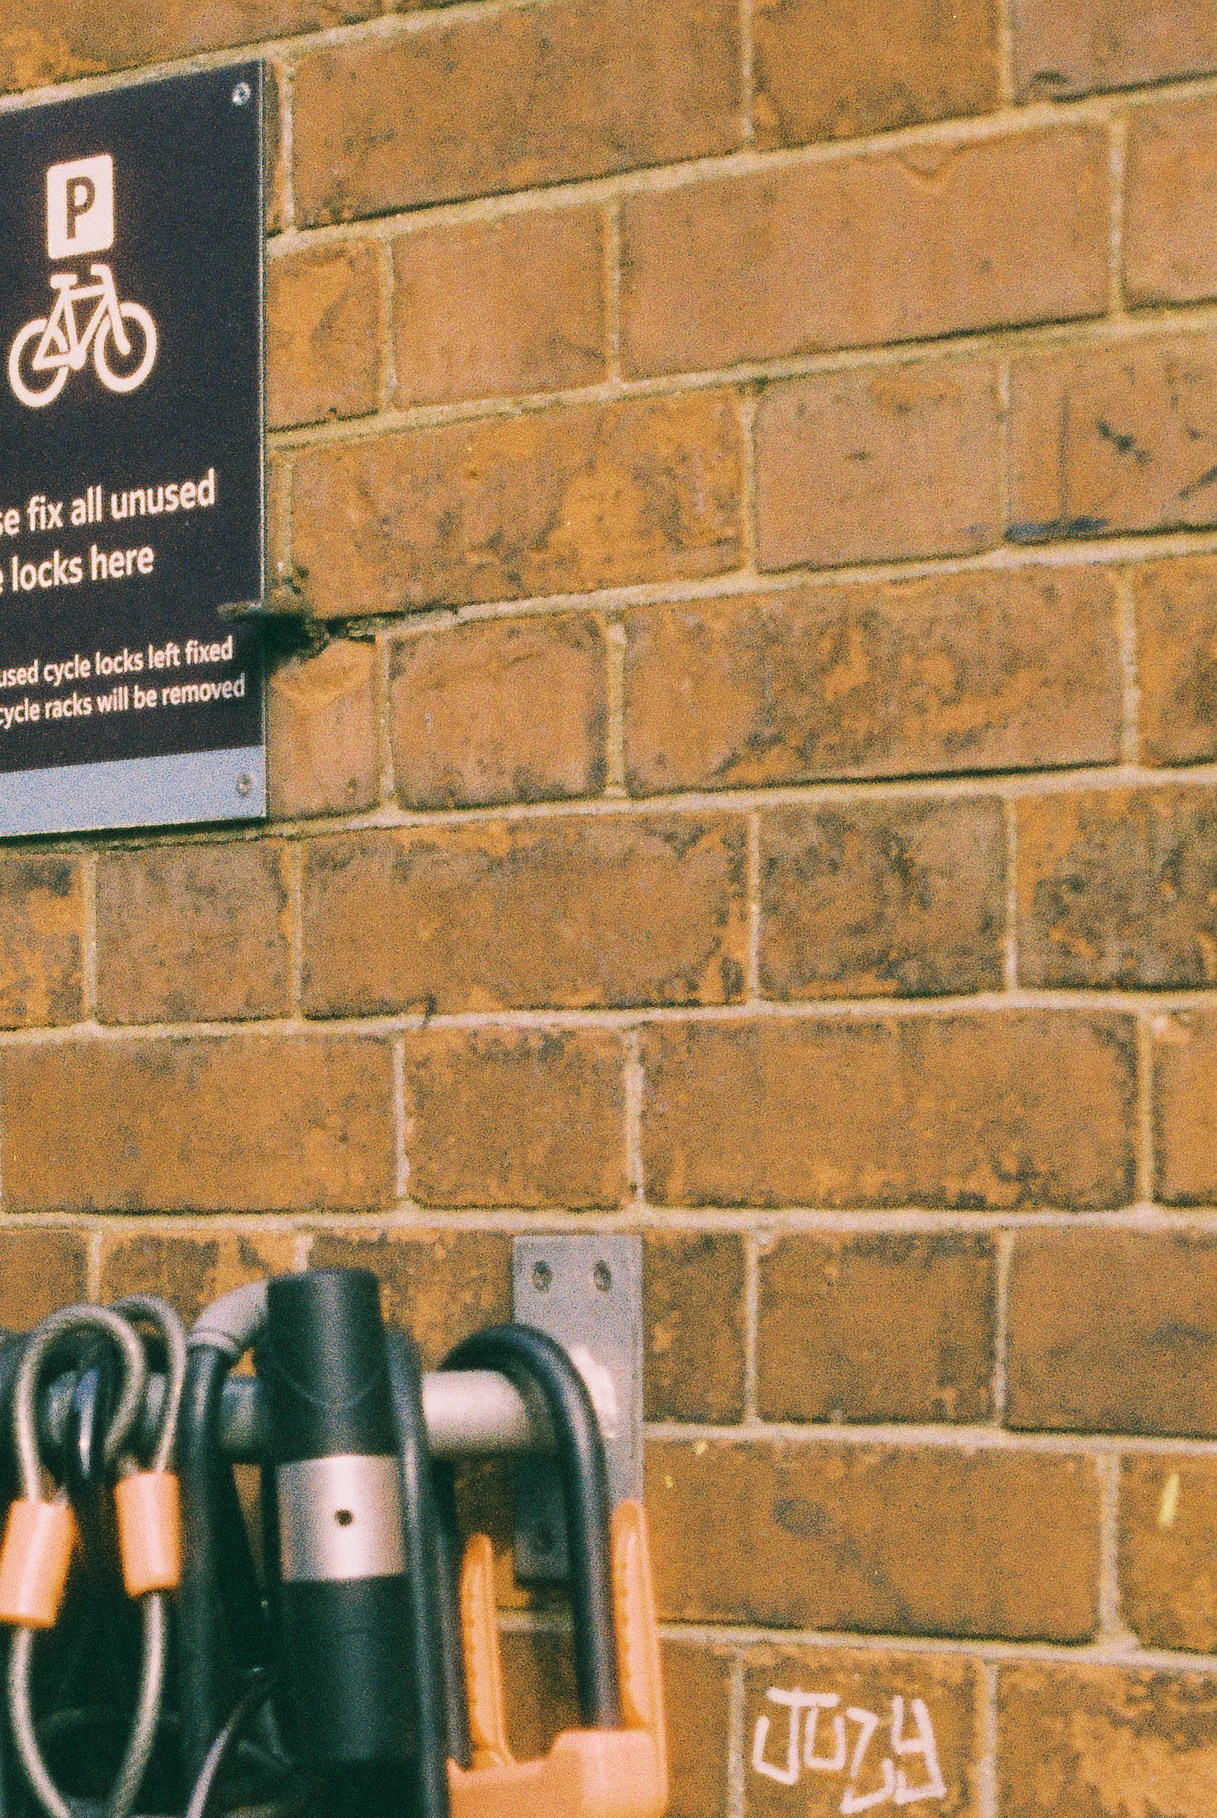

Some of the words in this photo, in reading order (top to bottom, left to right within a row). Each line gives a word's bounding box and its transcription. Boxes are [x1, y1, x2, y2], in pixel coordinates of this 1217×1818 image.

[66, 176, 96, 240] P
[26, 495, 64, 533] fix
[70, 484, 104, 527] all
[110, 467, 217, 521] unused
[11, 549, 84, 592] locks
[90, 543, 156, 582] here
[43, 654, 91, 688] cycle
[94, 647, 144, 677] locks
[147, 641, 182, 670] left
[184, 634, 234, 665] fixed
[43, 691, 93, 720] racks
[96, 685, 129, 713] will
[133, 684, 159, 710] be
[161, 674, 246, 706] removed
